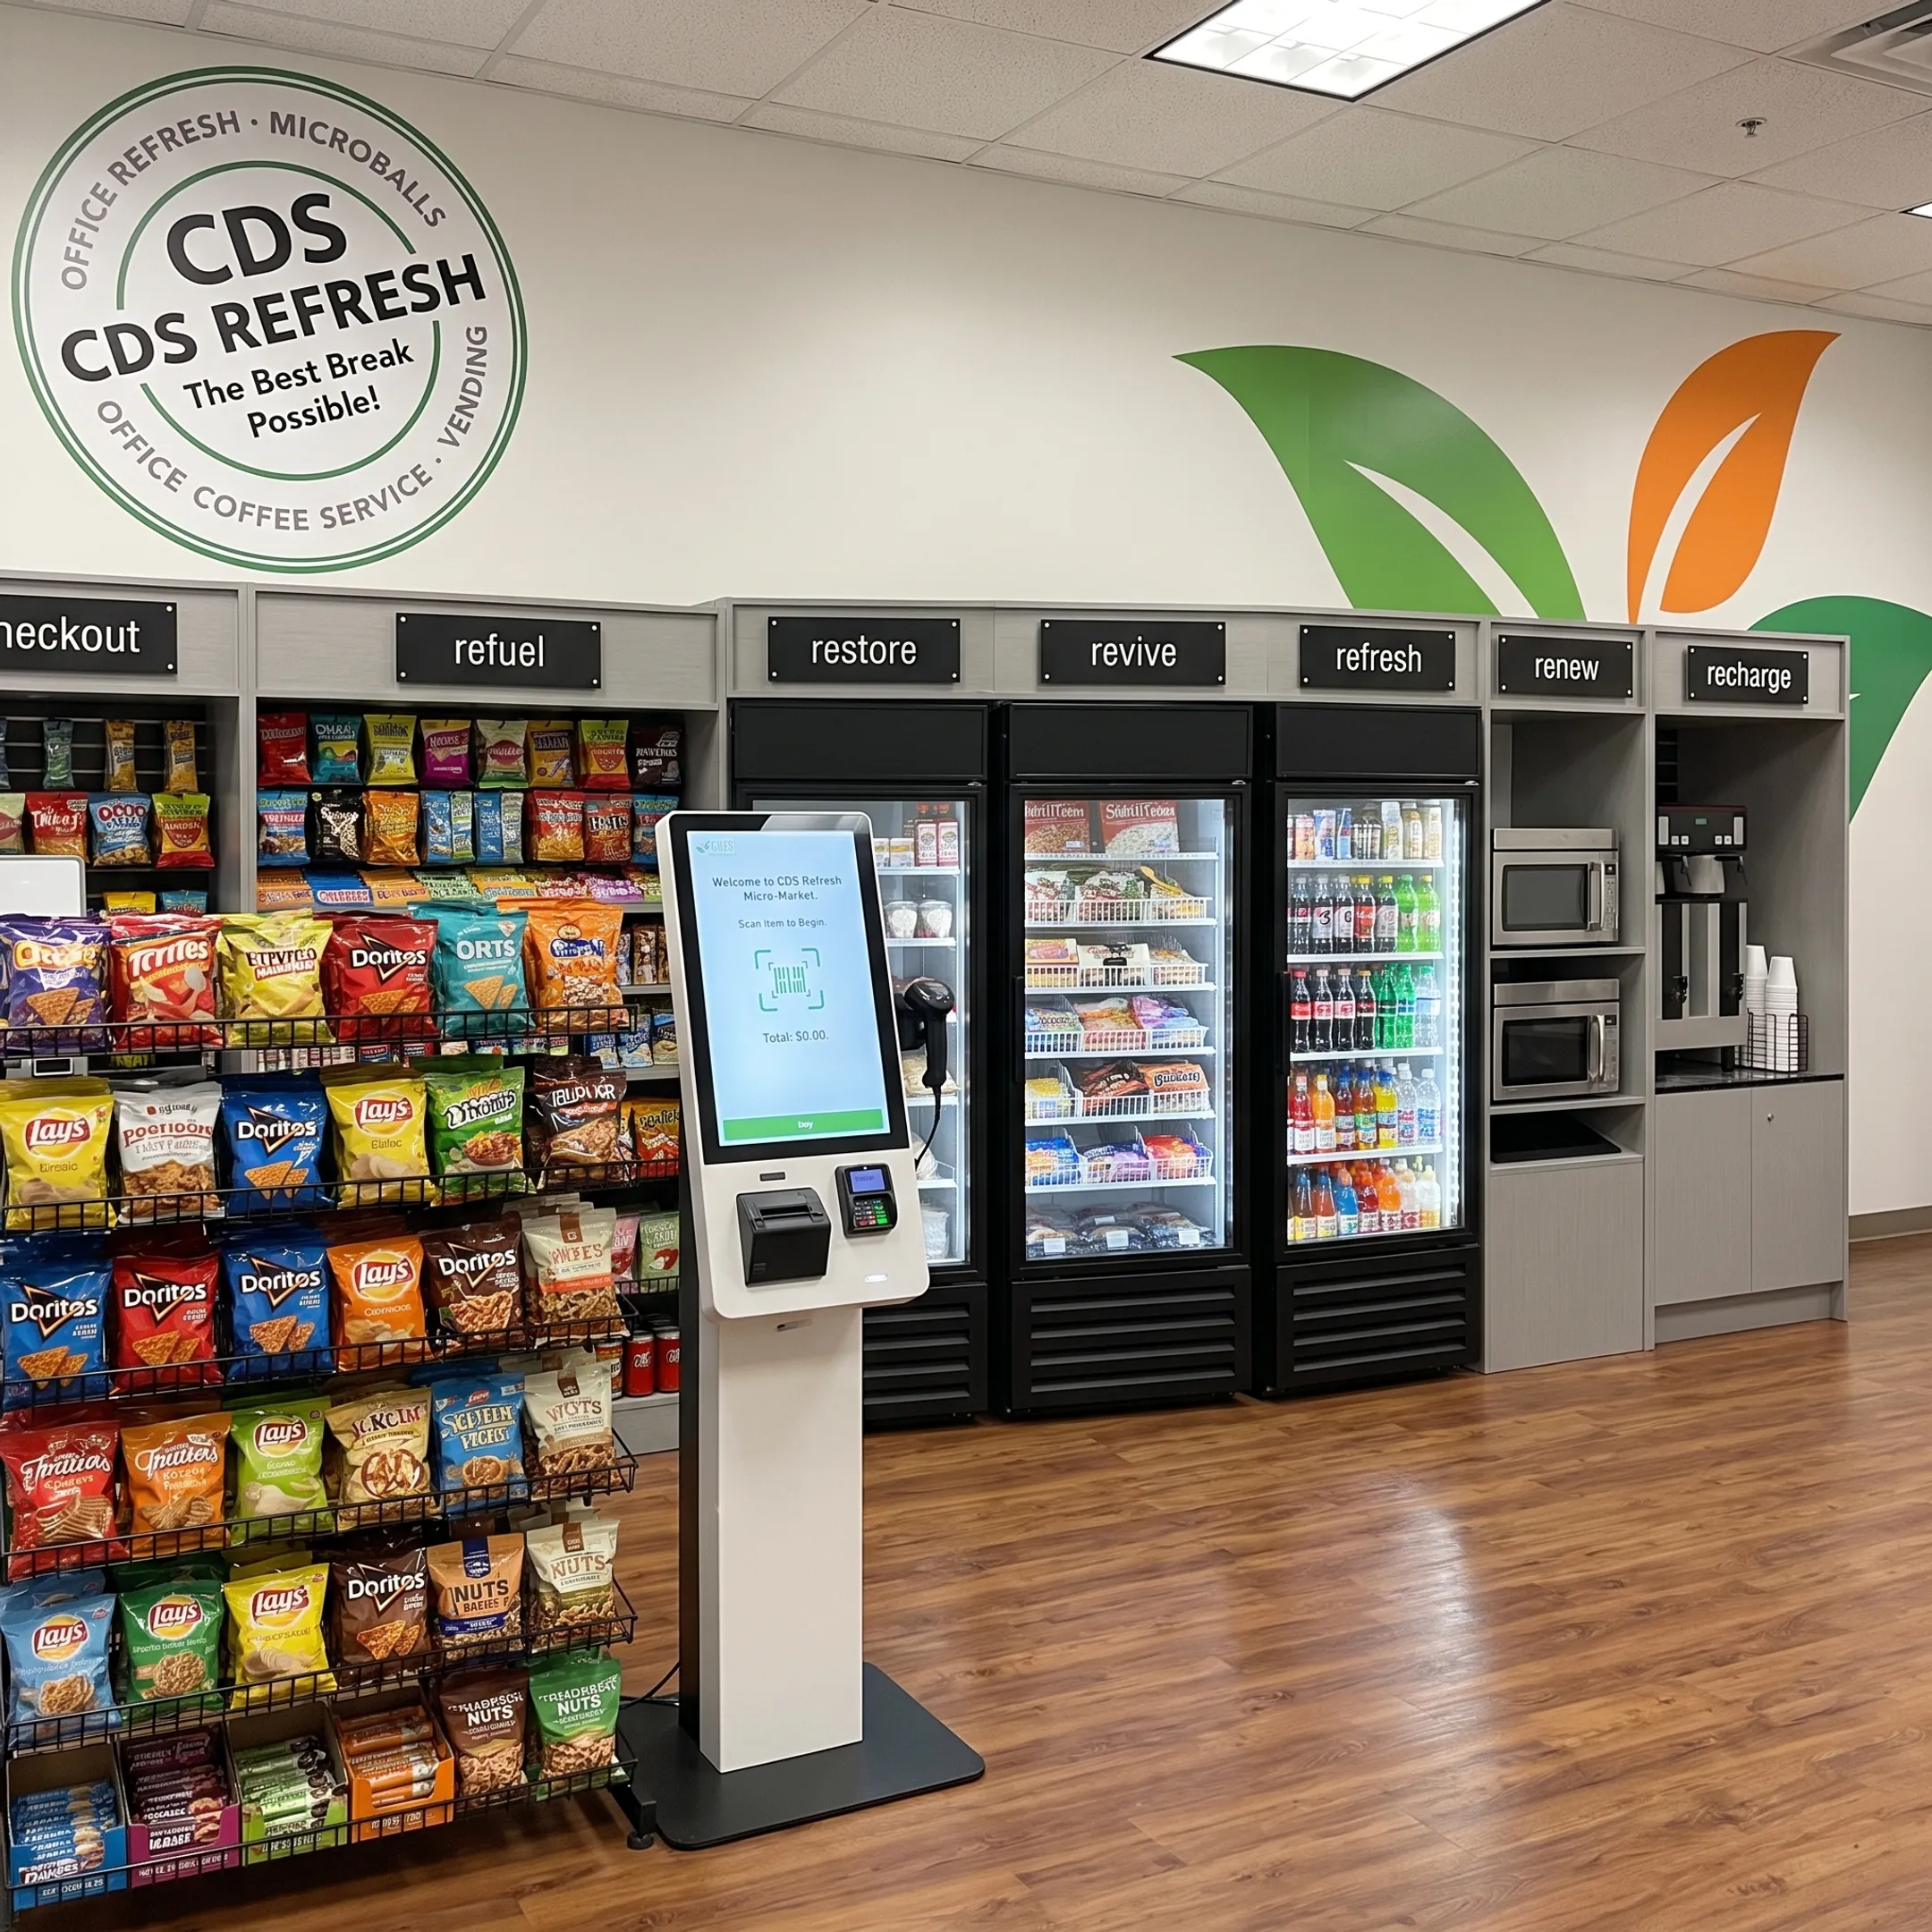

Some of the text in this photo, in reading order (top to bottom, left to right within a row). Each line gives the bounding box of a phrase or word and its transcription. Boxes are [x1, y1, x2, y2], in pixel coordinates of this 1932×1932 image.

[62, 110, 446, 290] OFFICE REFRESH MICROBALLS
[166, 193, 347, 285] CDS
[61, 253, 487, 382] CDS REFRESH
[182, 337, 415, 410] The Best Break
[247, 386, 382, 438] Possible!
[97, 325, 488, 531] OFFICE COFFEE SERVICE VENDING
[453, 633, 545, 667] refuel
[810, 634, 918, 665] restore
[1090, 636, 1178, 667] revive
[1335, 642, 1422, 673] refresh
[1534, 657, 1599, 682] renew
[1707, 661, 1792, 695] recharge
[712, 876, 843, 887] Welcome to CDS Refresh
[743, 890, 818, 902] Micro-Market.
[738, 918, 827, 928] Scan Item to Begin.
[352, 949, 427, 968] Doritos
[762, 1031, 793, 1044] Total:
[238, 1119, 316, 1140] Doritos
[437, 1249, 517, 1276] Doritos
[241, 1270, 321, 1294] Doritos
[124, 1283, 207, 1308] Doritos
[11, 1298, 97, 1321] Doritos
[348, 1572, 425, 1600] Doritos
[454, 1579, 509, 1603] NUTS
[467, 1704, 514, 1727] NUTS
[556, 1693, 602, 1716] NUTS
